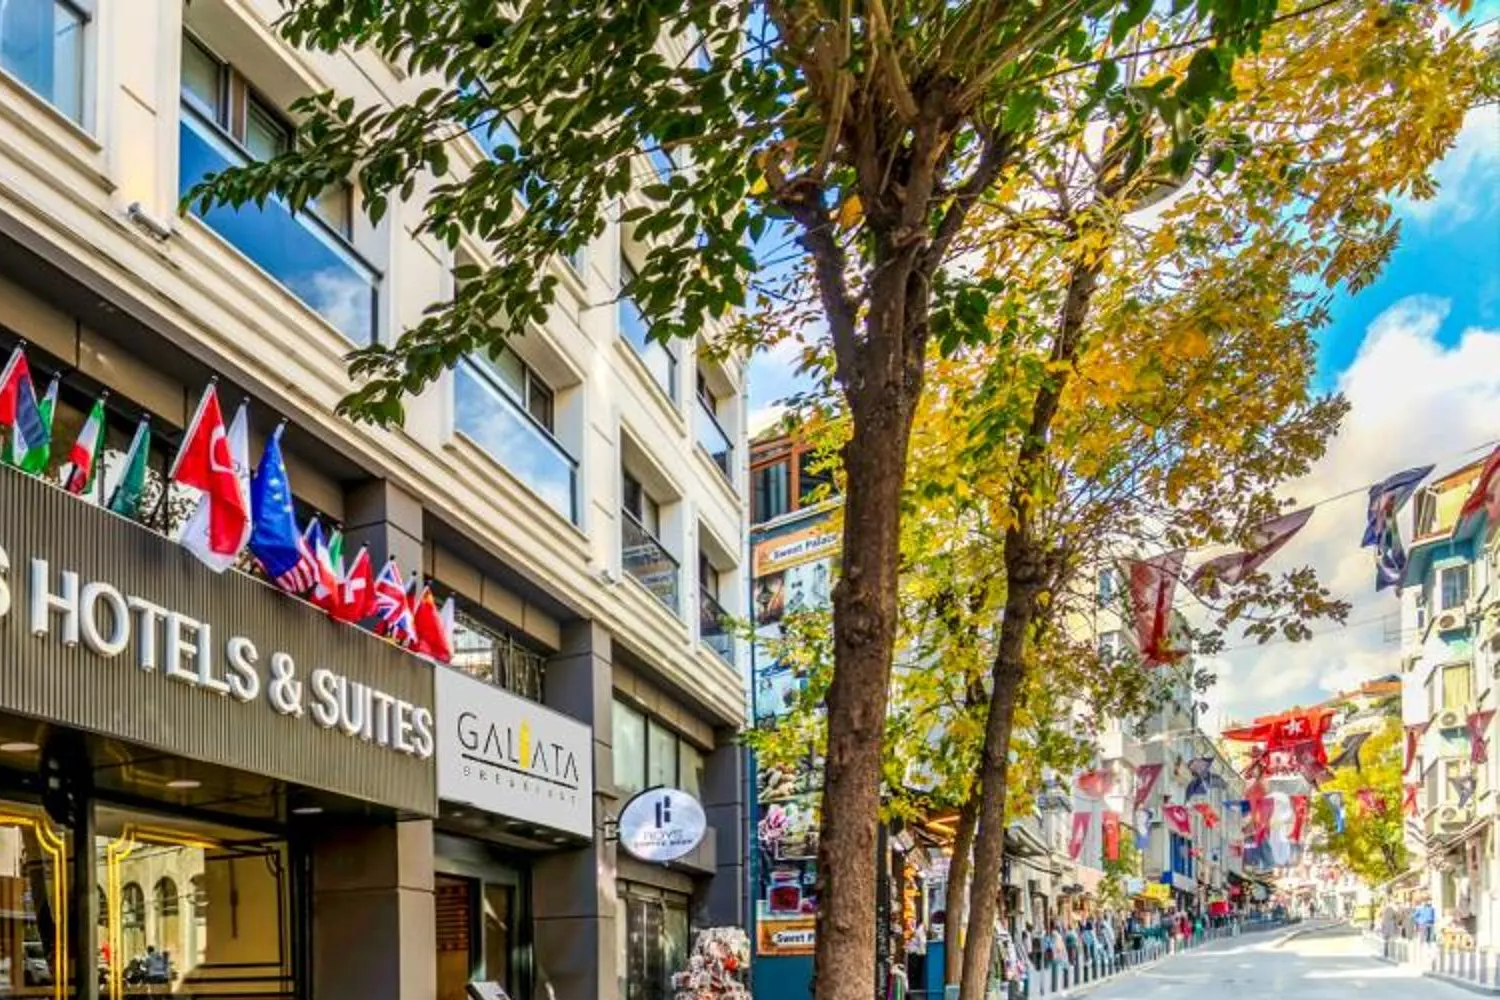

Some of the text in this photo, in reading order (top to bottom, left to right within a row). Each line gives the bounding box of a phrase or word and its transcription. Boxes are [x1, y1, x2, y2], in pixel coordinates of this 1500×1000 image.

[31, 557, 260, 703] HOTELS
[269, 651, 303, 718] &
[311, 669, 433, 759] SUITES
[457, 711, 579, 782] GALATA
